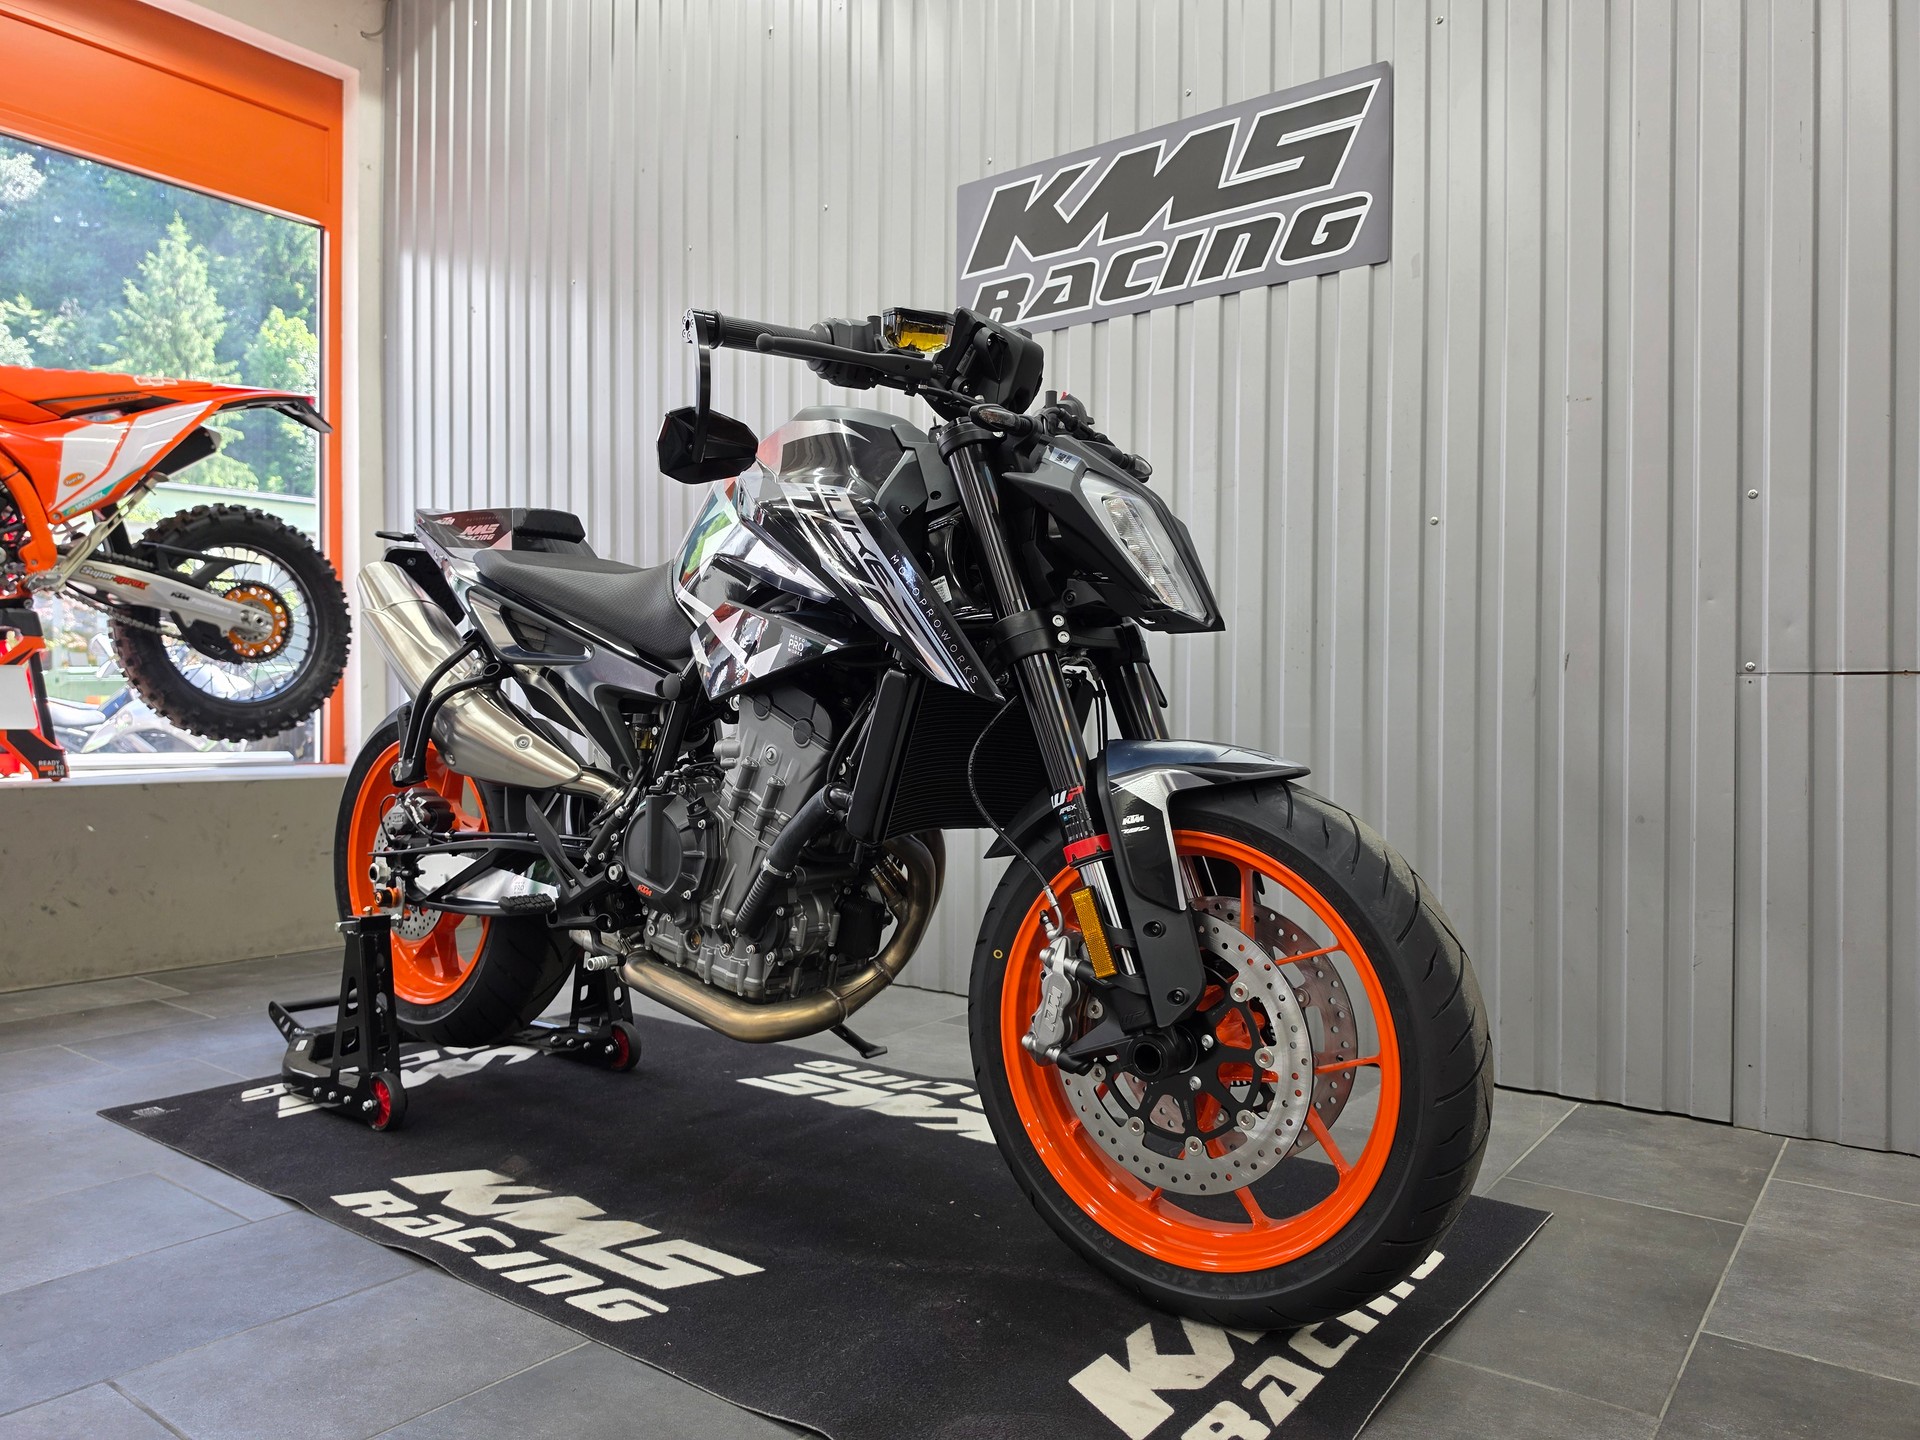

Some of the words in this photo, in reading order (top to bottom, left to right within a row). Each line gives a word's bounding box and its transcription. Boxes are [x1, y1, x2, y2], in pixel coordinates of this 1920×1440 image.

[961, 78, 1381, 280] KMS
[971, 192, 1373, 325] RACING
[461, 524, 499, 535] KMS
[788, 638, 804, 652] PRO
[1050, 786, 1084, 809] WP
[1059, 803, 1078, 815] APEX
[1122, 813, 1145, 825] KTM
[637, 884, 652, 896] KTM
[1044, 985, 1063, 1033] KTM
[794, 1060, 984, 1109] CING
[391, 1169, 766, 1290] KMS
[330, 1190, 669, 1322] RACING
[1151, 1263, 1277, 1294] MAXXIS
